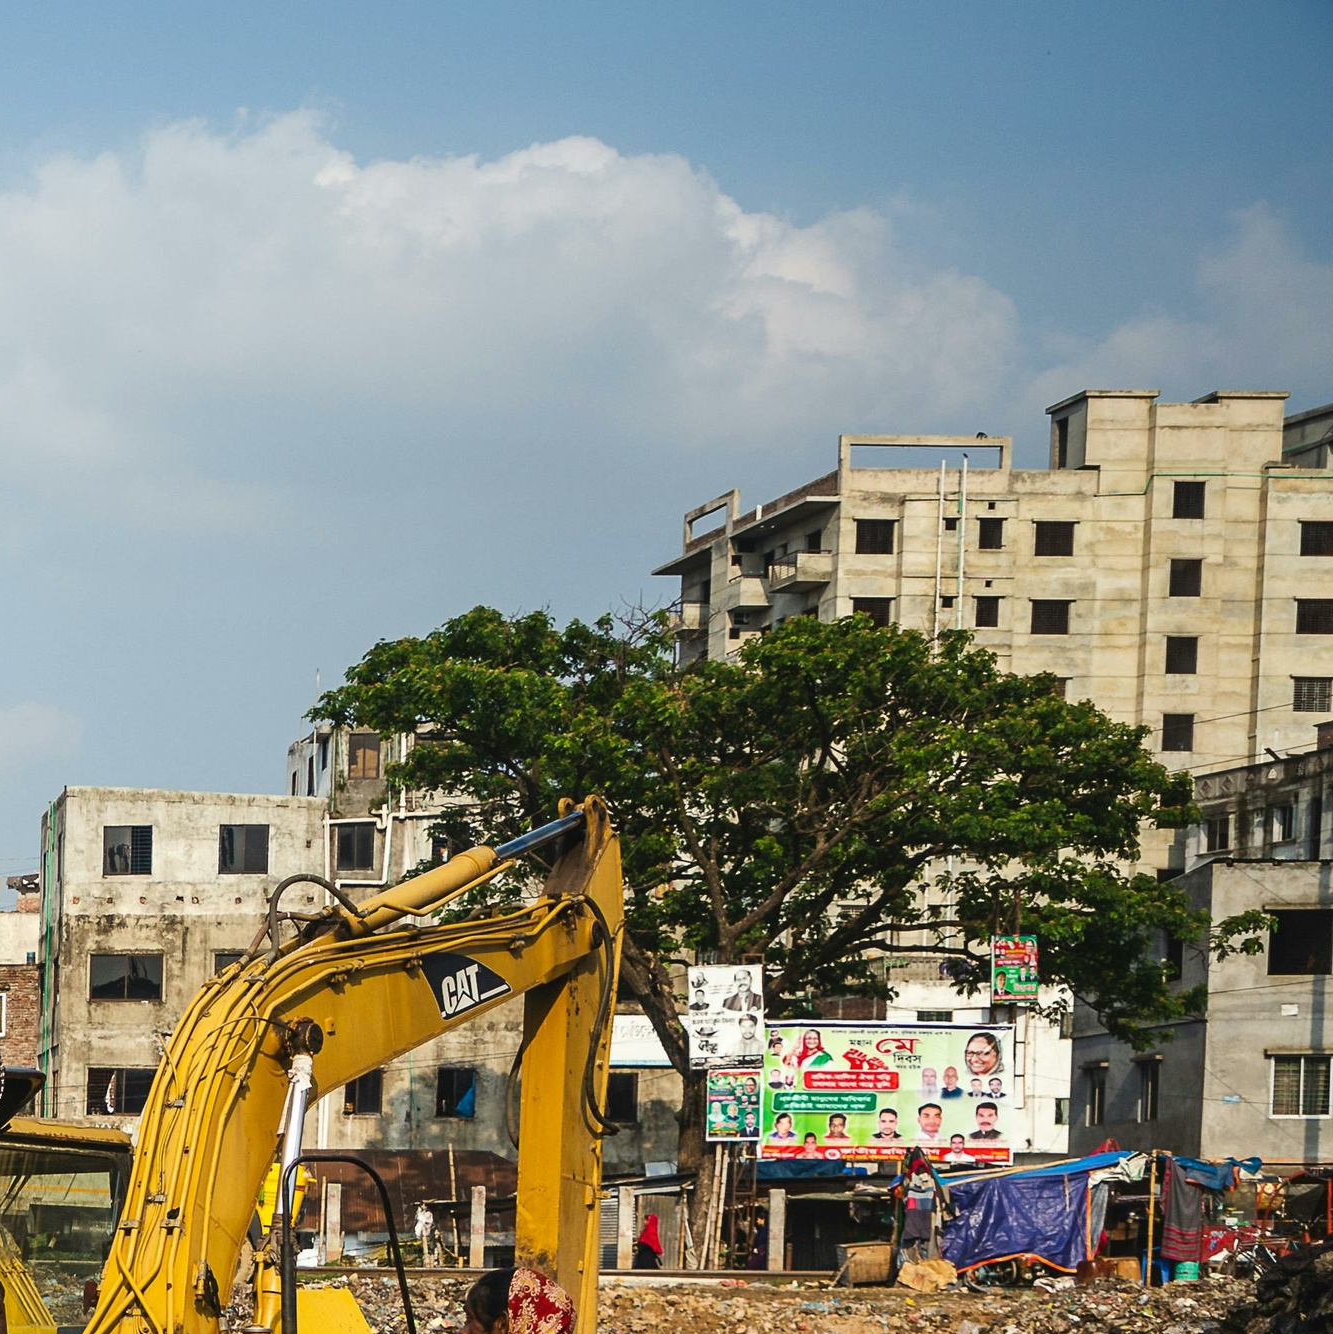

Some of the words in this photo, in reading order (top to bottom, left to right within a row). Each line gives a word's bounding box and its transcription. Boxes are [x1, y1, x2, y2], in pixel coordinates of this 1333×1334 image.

[441, 963, 479, 1014] CAT
[876, 1038, 920, 1054] মে
[893, 1052, 922, 1063] দিবস
